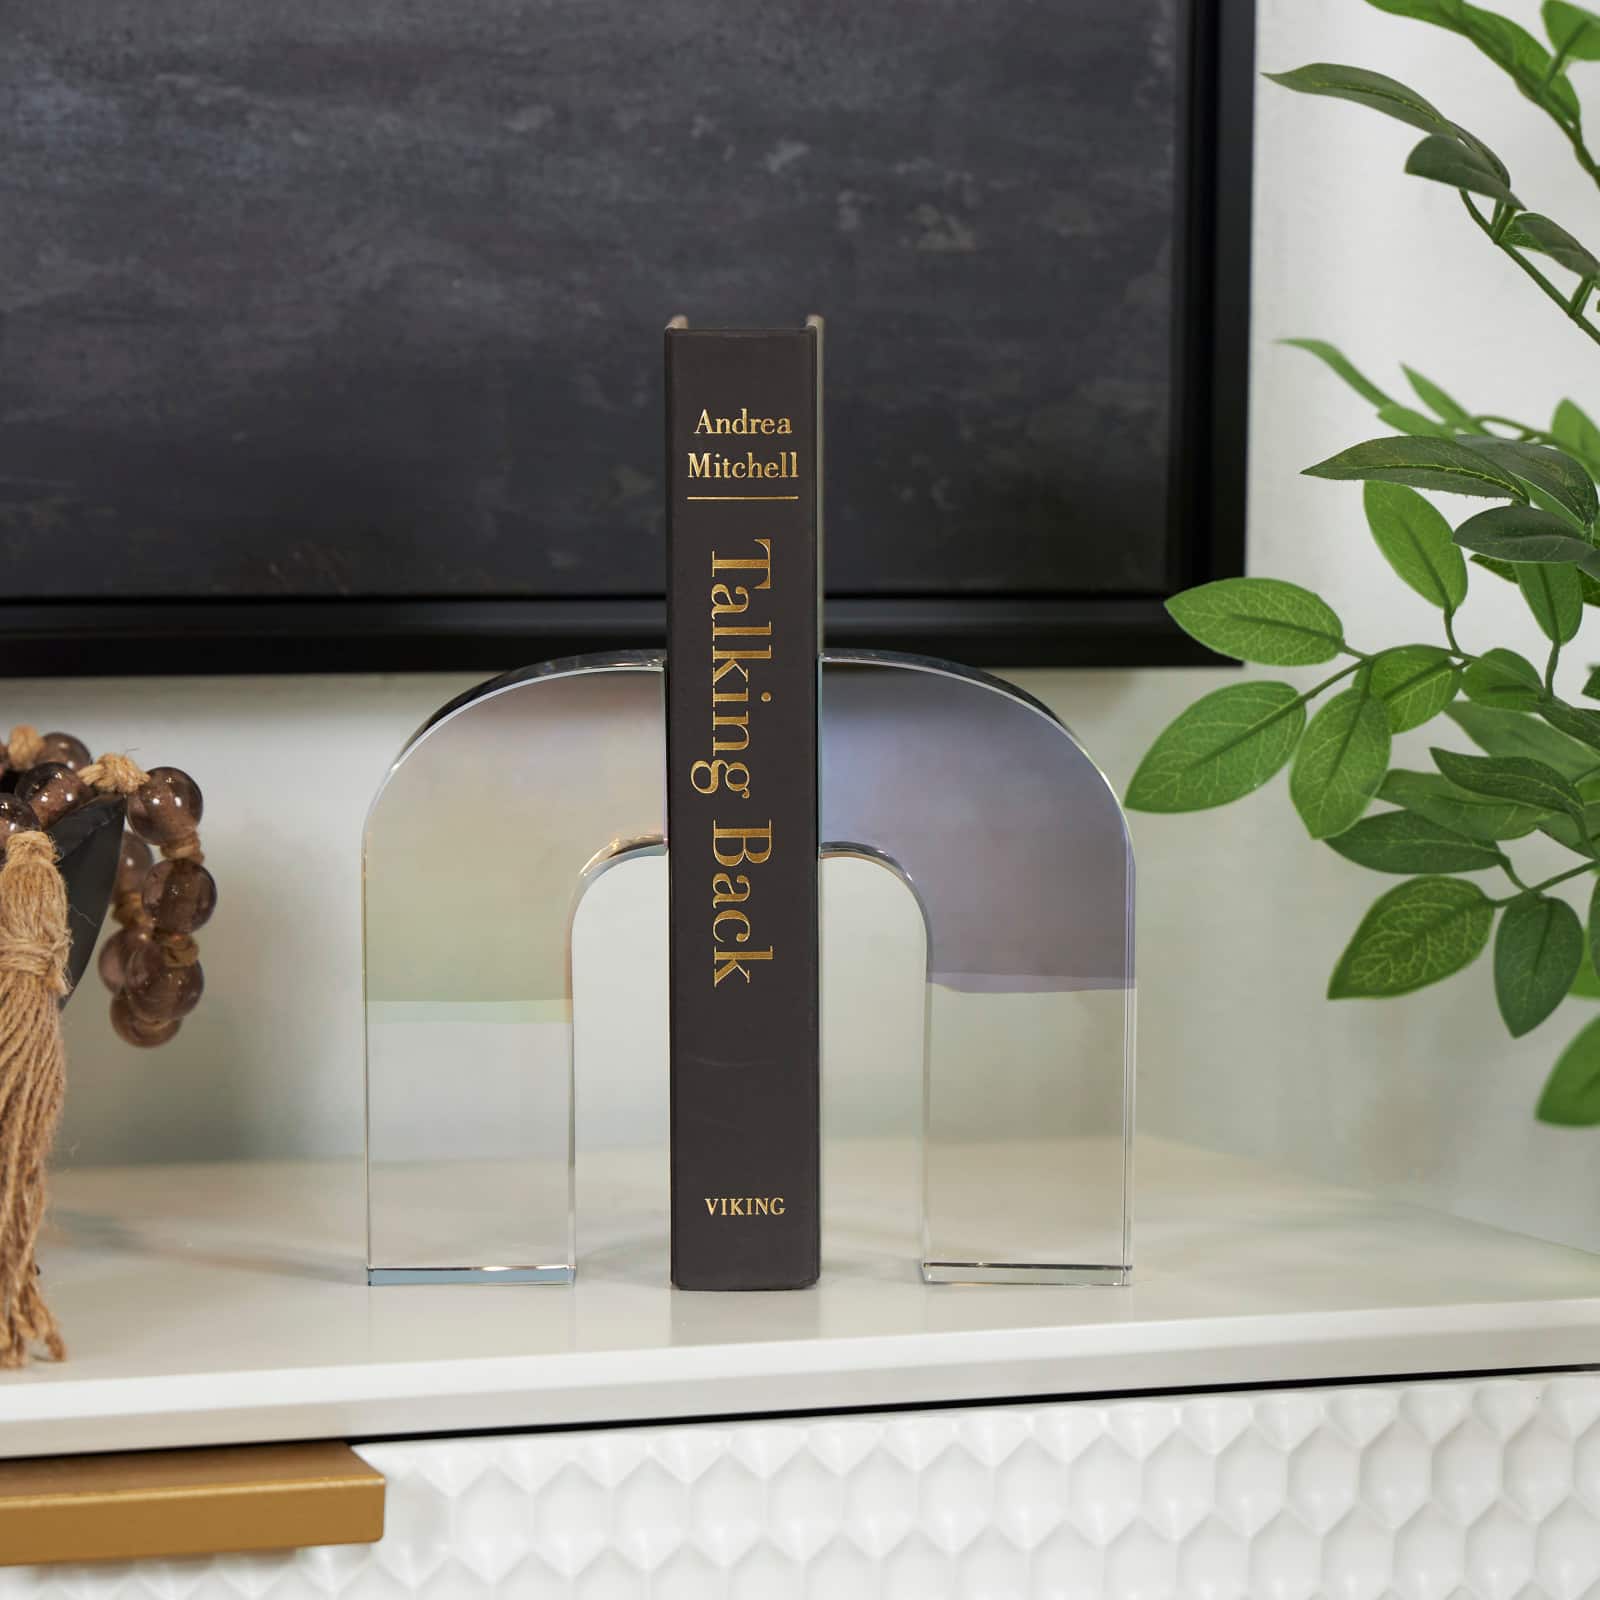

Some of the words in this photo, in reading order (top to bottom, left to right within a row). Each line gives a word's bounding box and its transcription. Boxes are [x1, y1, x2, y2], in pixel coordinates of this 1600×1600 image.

[694, 408, 792, 435] Andrea
[687, 451, 799, 479] Mitchell
[690, 537, 774, 800] Talking
[711, 819, 775, 987] Back
[705, 1196, 786, 1217] VIKING
